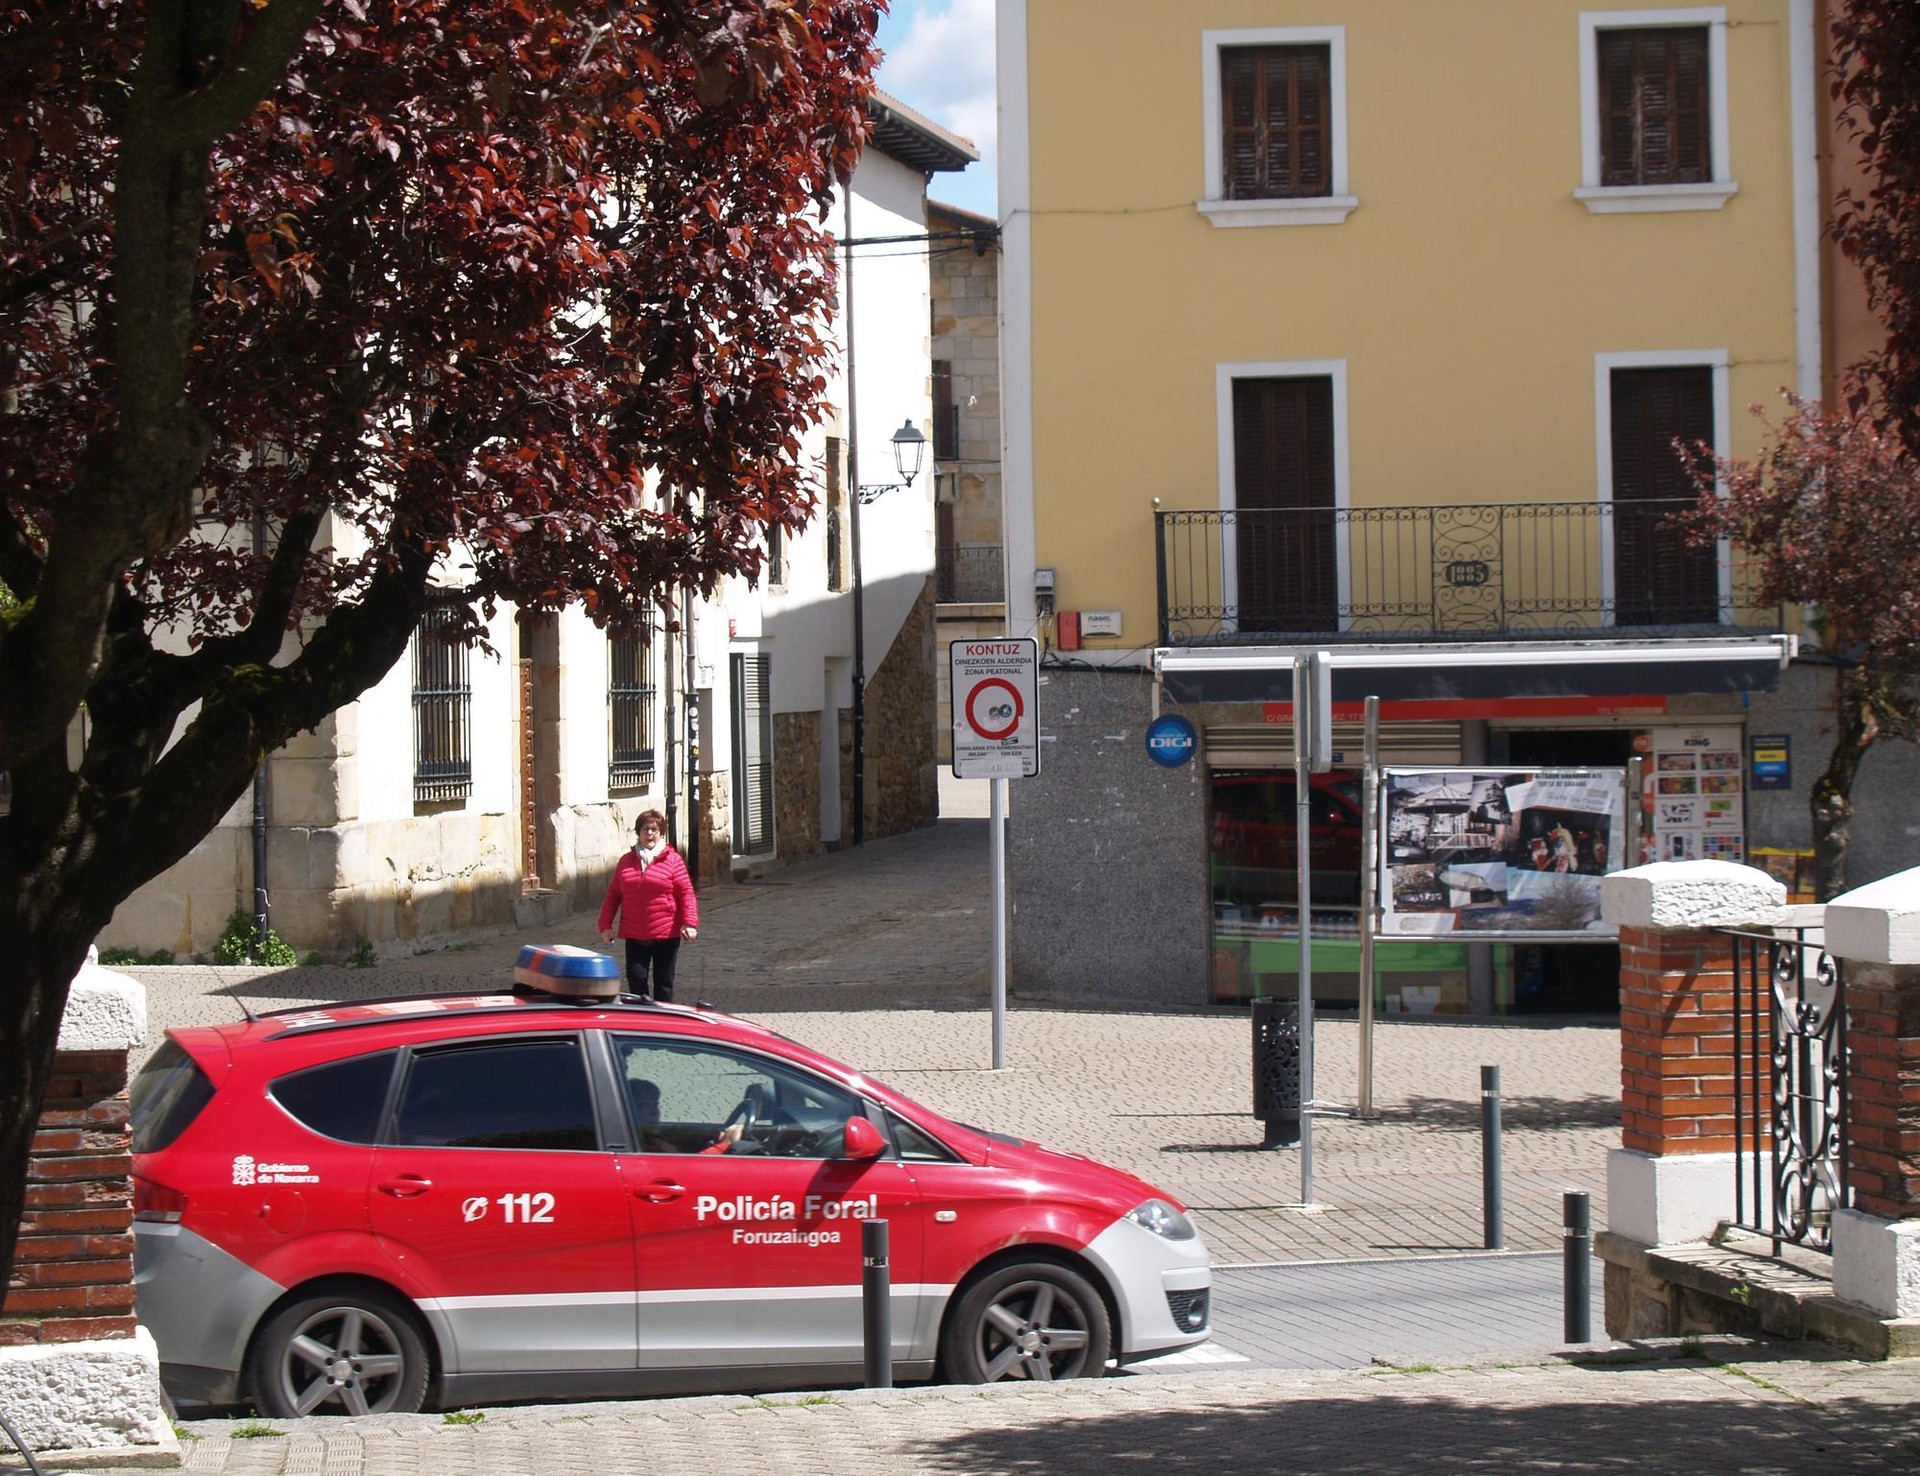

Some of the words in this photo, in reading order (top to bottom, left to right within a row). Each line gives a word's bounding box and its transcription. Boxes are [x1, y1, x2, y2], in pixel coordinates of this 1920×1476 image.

[966, 644, 1020, 656] KONTUZ
[955, 658, 995, 666] OINEZKOEN
[964, 668, 985, 676] ZONA
[1150, 737, 1192, 748] DIGI
[1683, 738, 1710, 747] KING
[257, 1163, 310, 1173] Gobierno
[257, 1173, 273, 1184] de
[274, 1173, 320, 1184] Navarra
[496, 1191, 556, 1223] 112
[693, 1194, 796, 1221] Policía
[804, 1194, 878, 1220] Foral
[732, 1229, 841, 1248] Foruzaingoa
